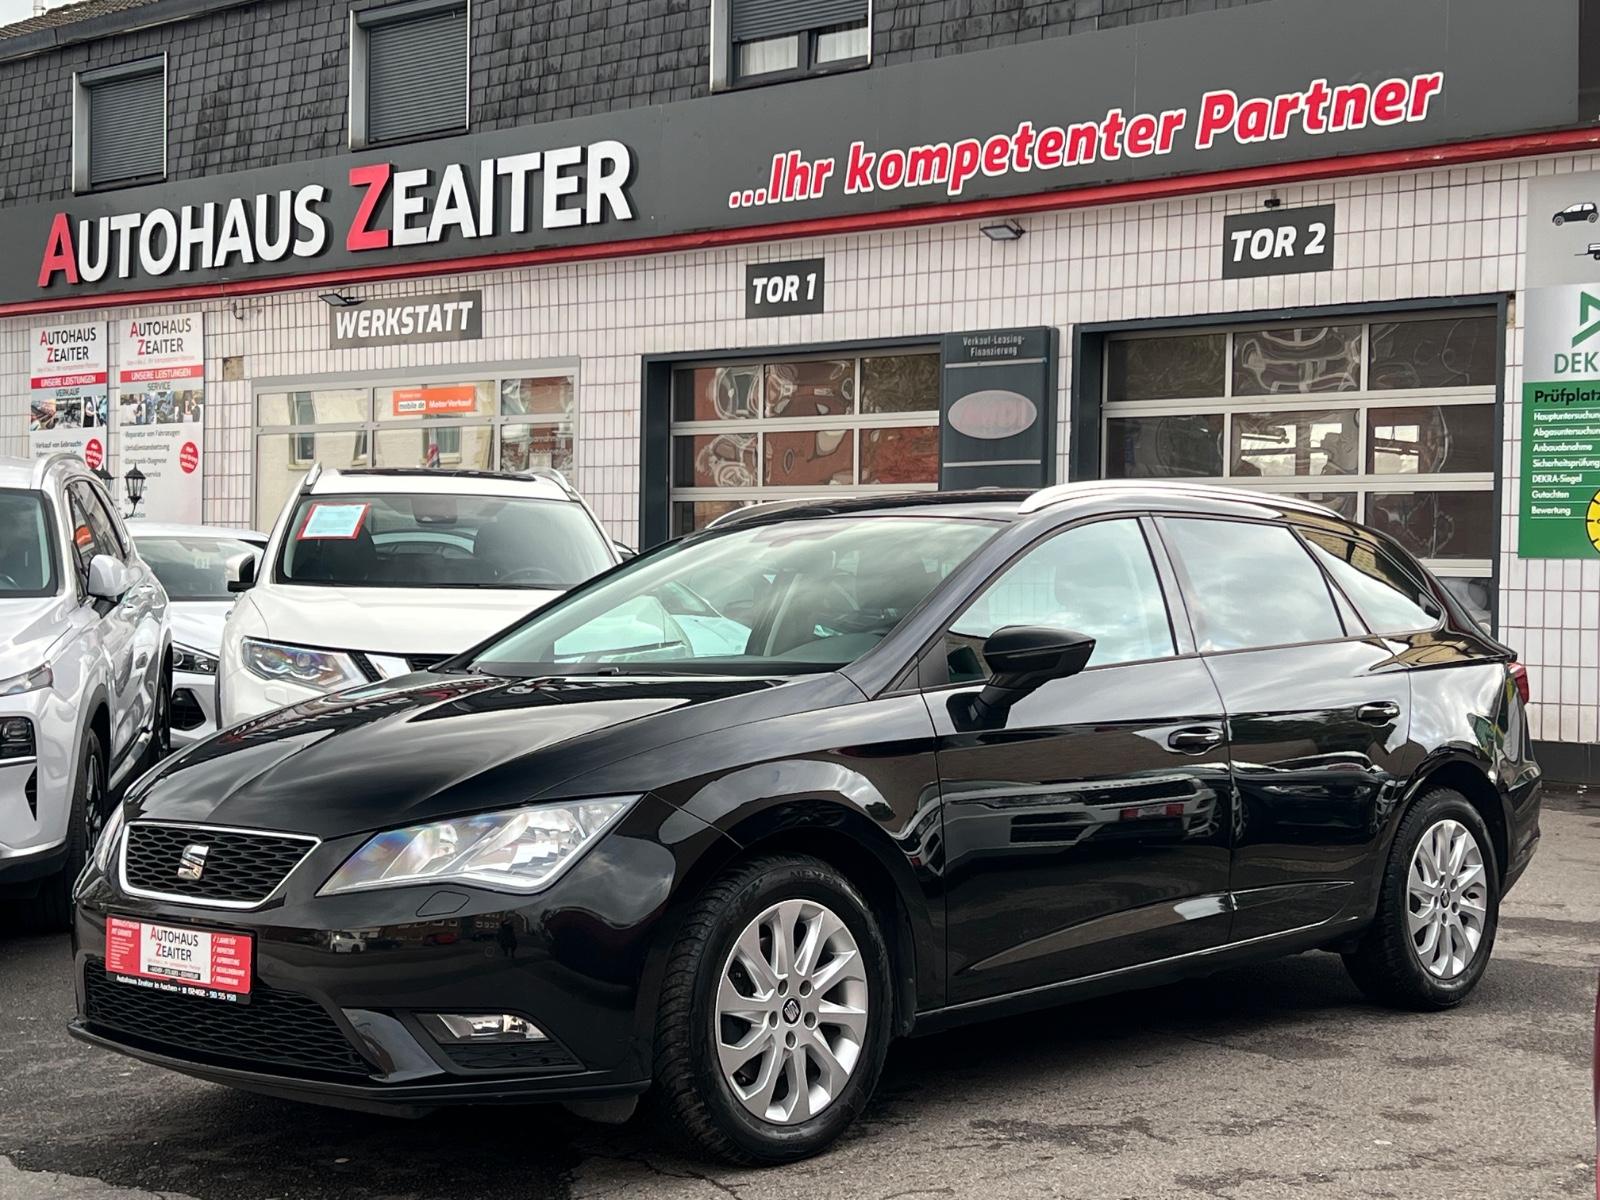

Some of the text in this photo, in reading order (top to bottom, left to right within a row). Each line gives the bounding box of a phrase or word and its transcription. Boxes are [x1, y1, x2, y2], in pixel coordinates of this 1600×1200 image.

[844, 108, 1187, 195] kompetenter
[1195, 71, 1445, 149] Partner
[37, 139, 634, 288] AUTOHAUS ZEAITER
[1230, 222, 1327, 263] TOR 2
[752, 273, 817, 305] TOR 1
[130, 318, 192, 338] AUTOHAUS
[335, 300, 474, 340] WERKSTATT
[40, 327, 97, 346] AUTOHAUS
[47, 346, 89, 363] ZEAITER
[137, 338, 184, 356] ZEAITER
[970, 346, 1018, 357] Finanzierung
[40, 374, 97, 388] UNSERE LEISTUNGEN
[131, 367, 192, 381] UNSERE LEISTUNGEN
[56, 387, 80, 397] VERKAUF
[147, 382, 171, 391] SERVICE
[1533, 410, 1600, 422] Hauptuntersuchun
[1533, 442, 1593, 452] Anbauabnahme
[1532, 474, 1582, 484] DEKRA-Siegel
[1531, 490, 1569, 499] Gutachten
[1531, 506, 1571, 516] Bewertung
[151, 926, 199, 948] AUTOHAUS
[156, 943, 192, 962] ZEAITER
